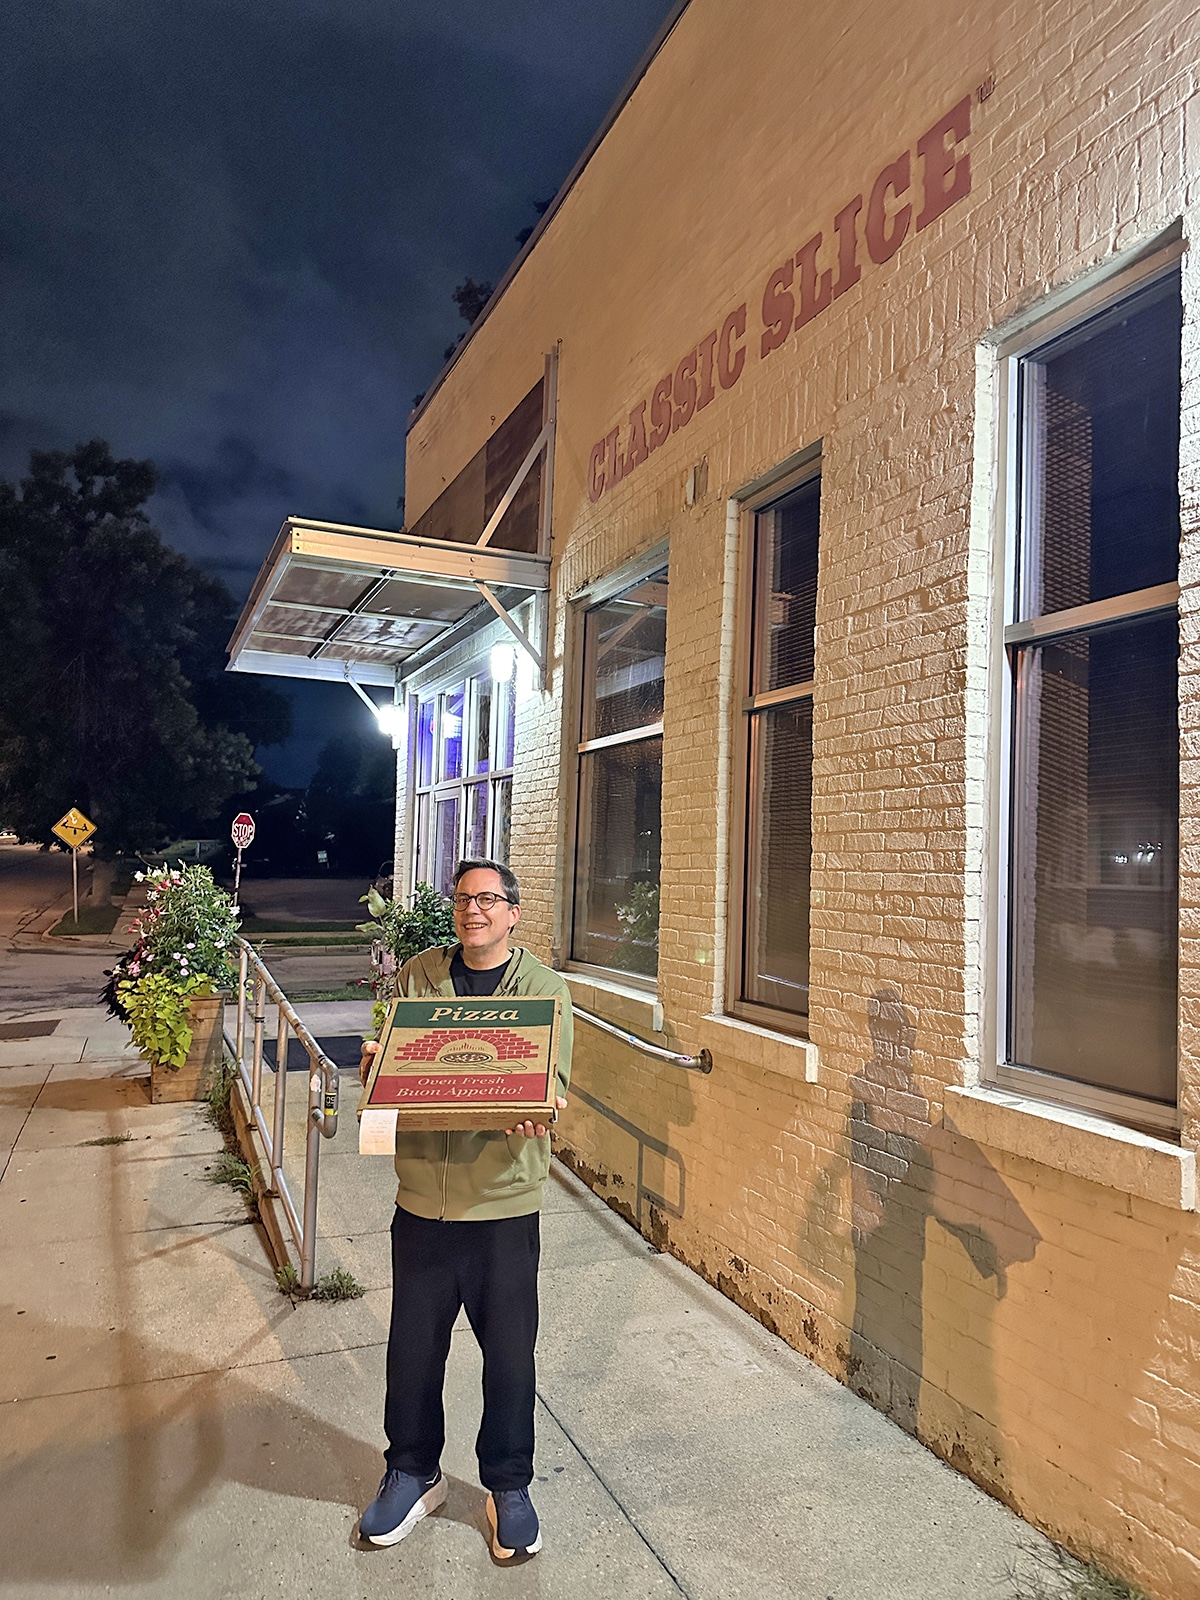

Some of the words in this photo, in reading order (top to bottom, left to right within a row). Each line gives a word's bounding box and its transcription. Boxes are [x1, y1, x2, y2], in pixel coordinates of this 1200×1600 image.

[587, 303, 747, 502] CLASSIC
[760, 94, 971, 359] SLICE
[233, 823, 253, 837] STOP
[428, 1007, 519, 1021] Pizza
[418, 1078, 457, 1086] Oven
[462, 1076, 505, 1085] Fresh
[396, 1088, 441, 1097] Buon
[444, 1086, 524, 1097] Appetito!
